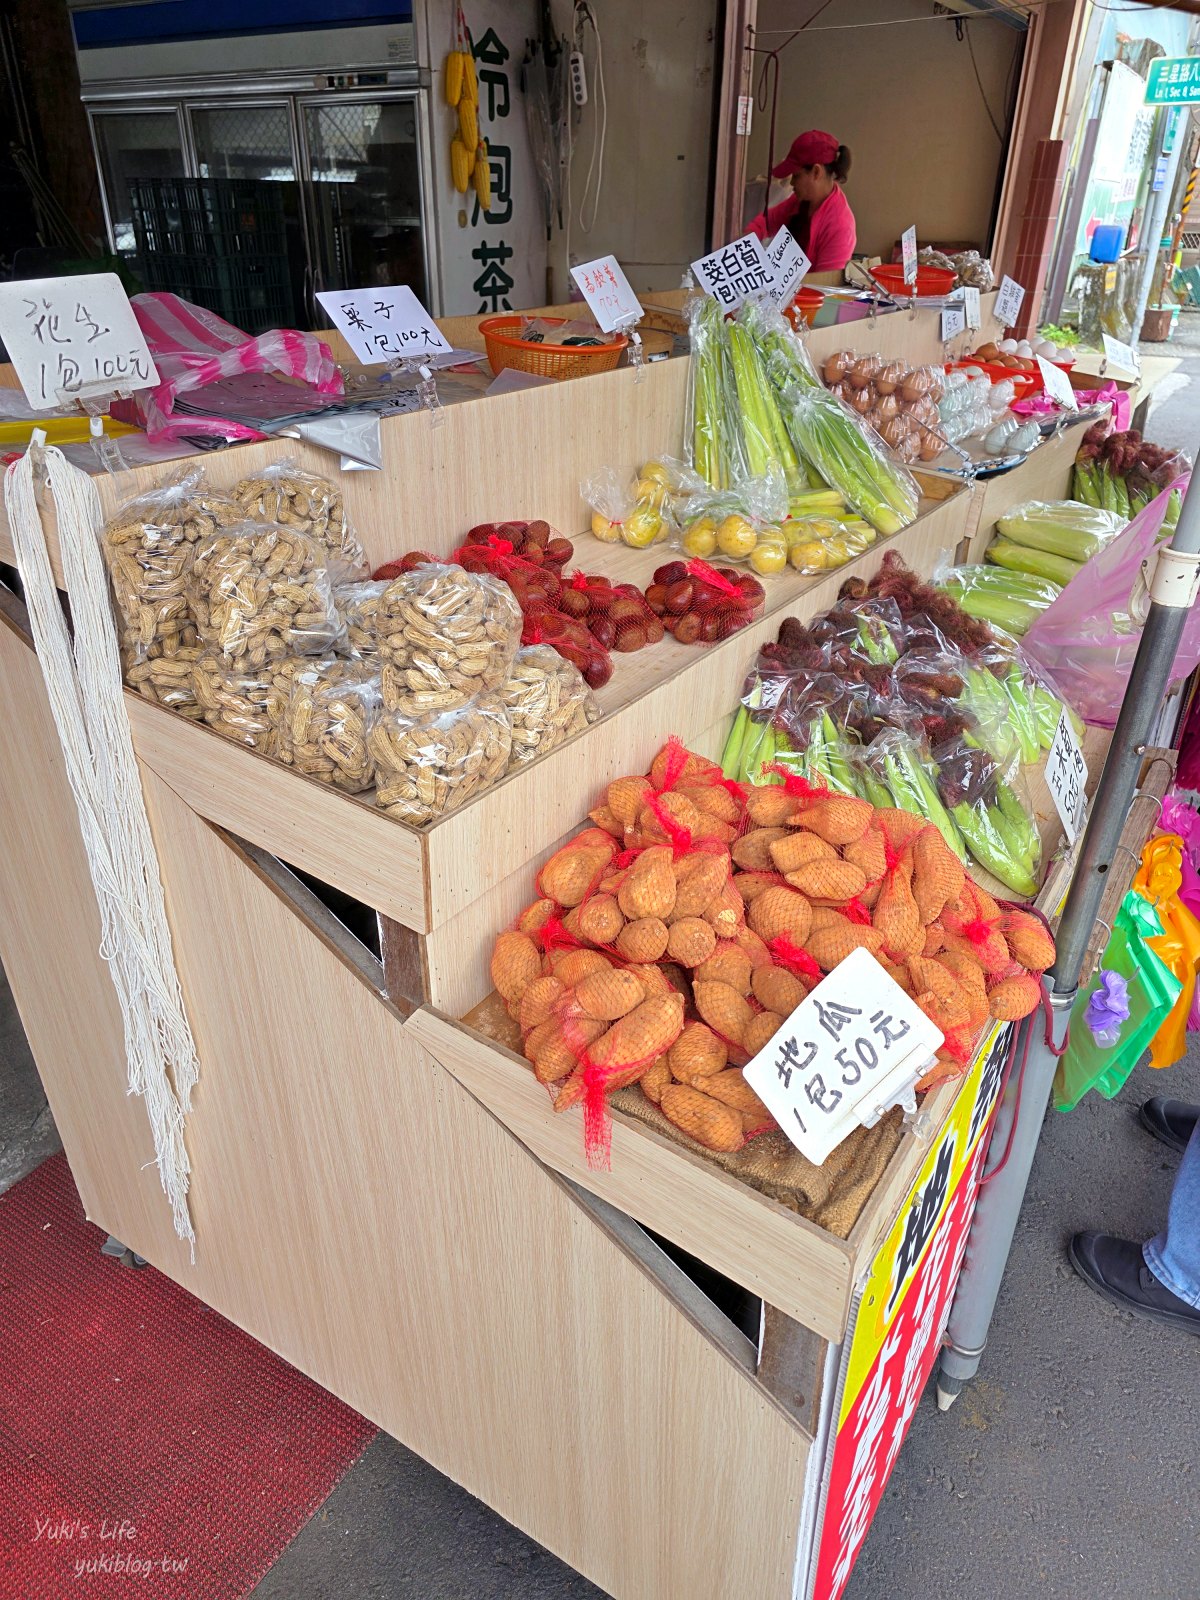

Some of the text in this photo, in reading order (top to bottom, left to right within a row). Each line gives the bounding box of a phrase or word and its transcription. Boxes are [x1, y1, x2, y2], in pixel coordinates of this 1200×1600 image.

[1158, 63, 1200, 83] 三星路八
[22, 298, 111, 345] 花生
[341, 301, 395, 332] 栗子
[774, 999, 863, 1089] 地瓜
